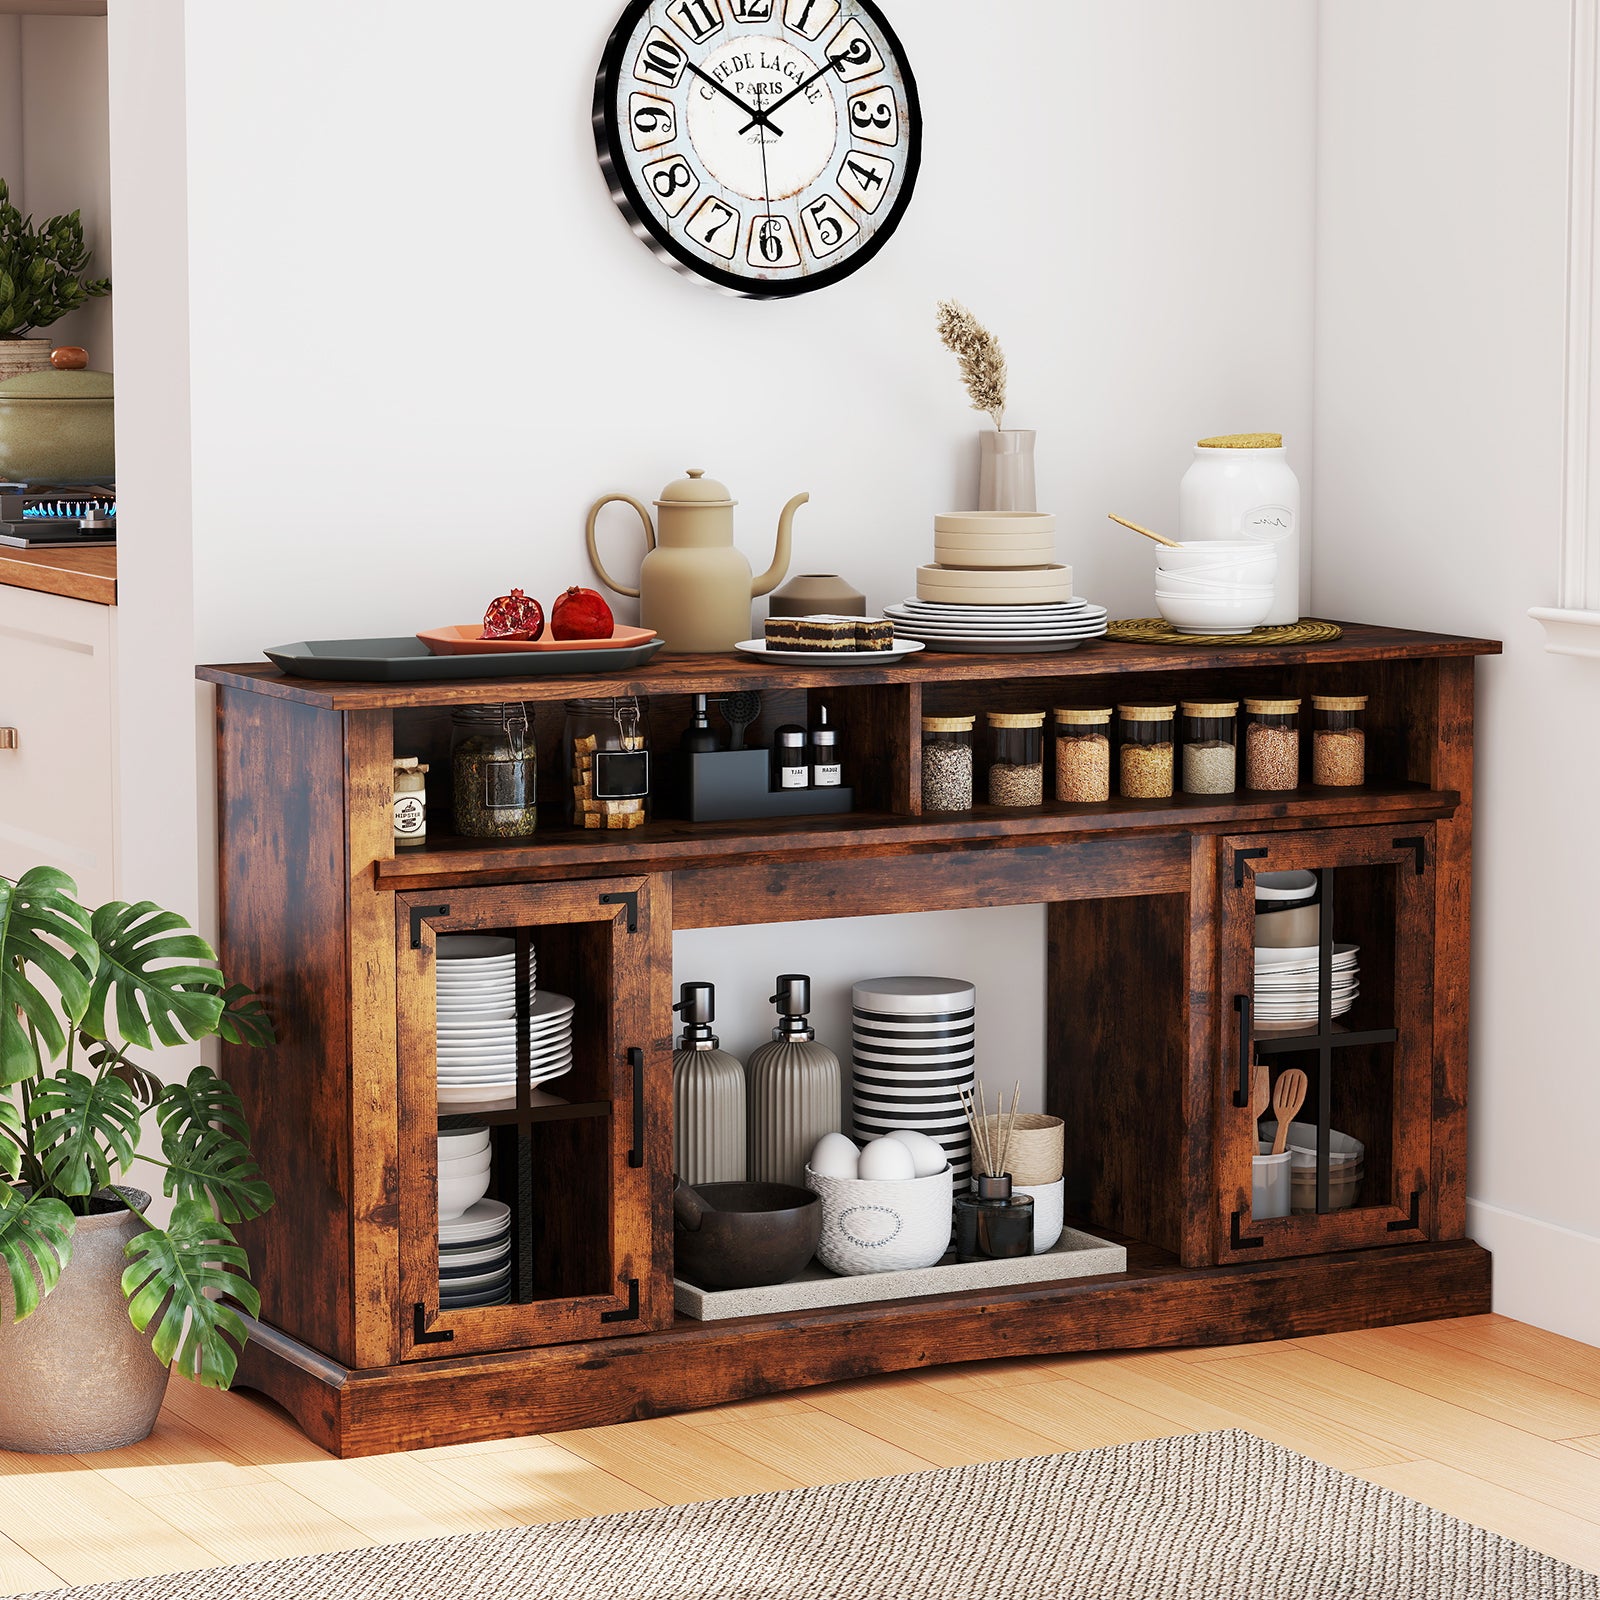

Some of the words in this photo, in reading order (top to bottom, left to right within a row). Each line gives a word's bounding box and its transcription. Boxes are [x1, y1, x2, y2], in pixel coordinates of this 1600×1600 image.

[677, 0, 722, 41] 11
[791, 0, 816, 34] 1
[643, 40, 682, 86] 10
[829, 38, 872, 73] 2
[735, 81, 783, 95] PARIS
[634, 106, 673, 133] 9
[851, 100, 892, 129] 3
[653, 163, 691, 197] 8
[846, 159, 884, 192] 4
[704, 202, 734, 244] 7
[810, 200, 843, 246] 5
[758, 219, 784, 262] 6
